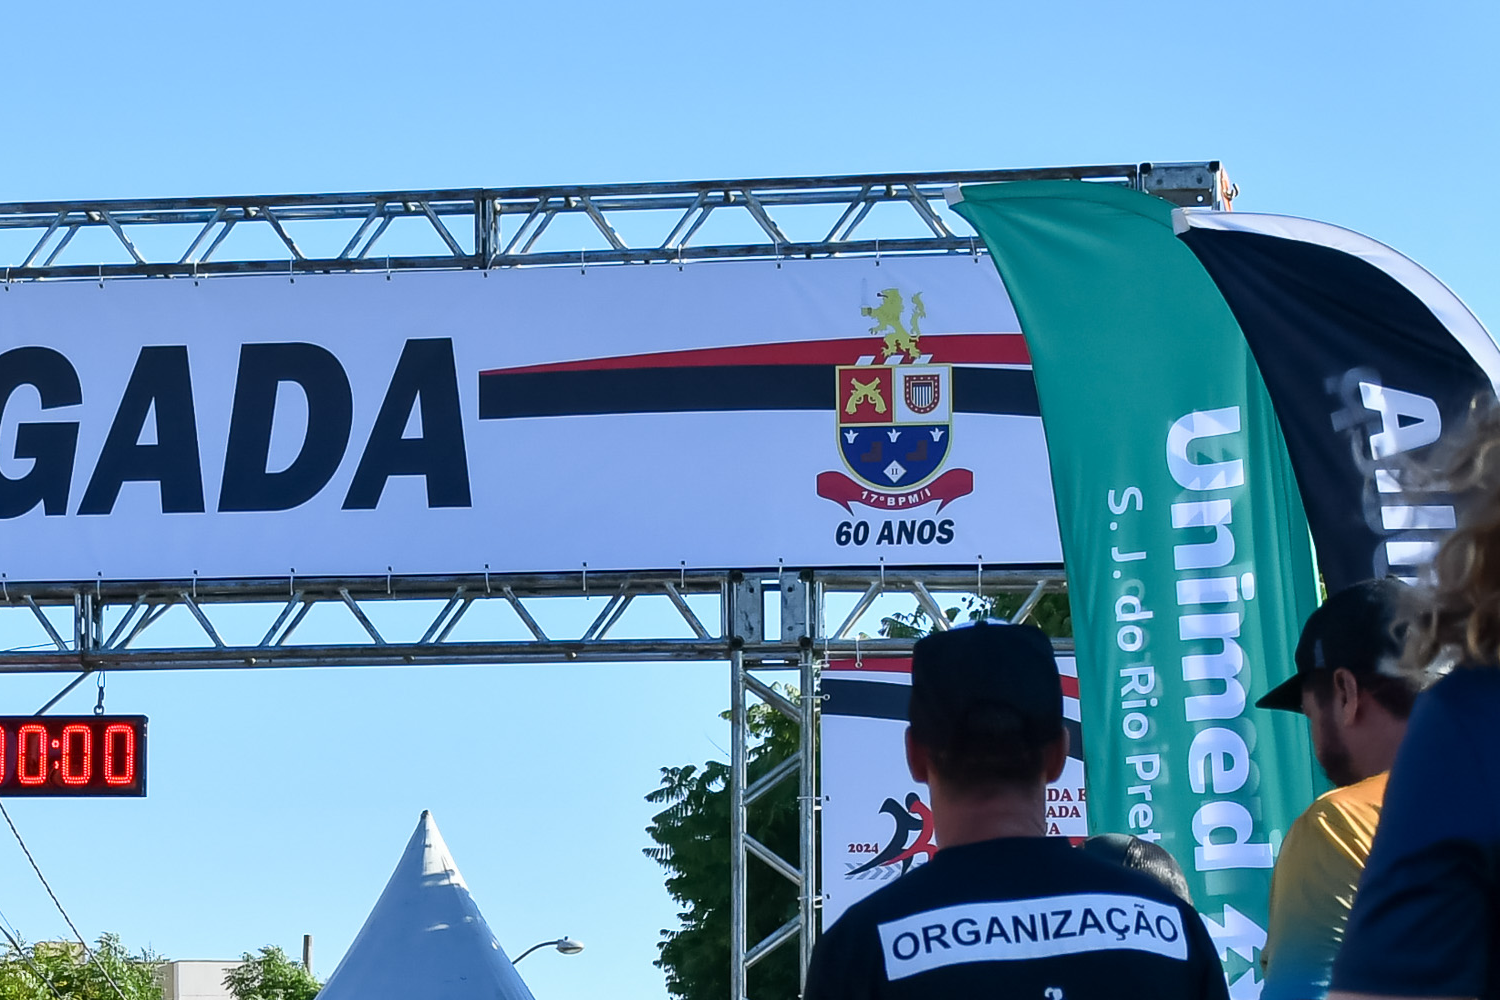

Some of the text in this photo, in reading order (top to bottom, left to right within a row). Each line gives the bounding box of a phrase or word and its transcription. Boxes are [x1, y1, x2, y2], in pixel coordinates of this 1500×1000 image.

[835, 519, 955, 546] 60 ANOS
[1108, 487, 1163, 842] S. J. do Rio Pret
[1166, 406, 1274, 870] Unimed
[848, 843, 879, 854] 2024
[891, 903, 1179, 961] ORGANIZAÇÃO
